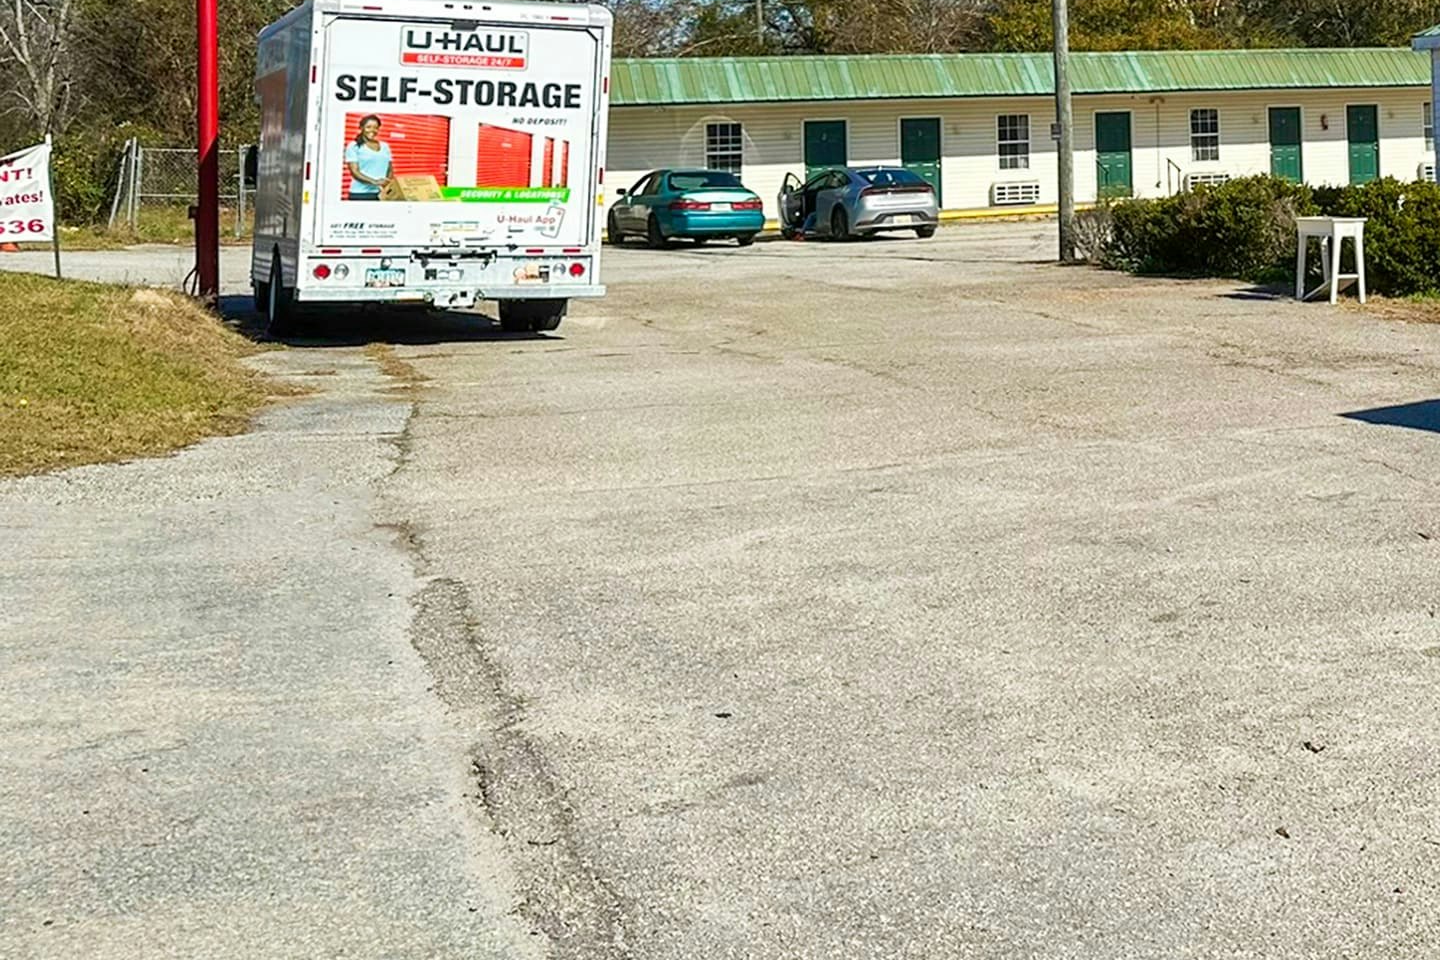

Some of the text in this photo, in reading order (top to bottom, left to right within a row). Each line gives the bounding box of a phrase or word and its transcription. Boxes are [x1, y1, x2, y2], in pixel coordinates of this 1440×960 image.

[407, 30, 523, 53] U-HAUL
[416, 54, 488, 65] SELF-STORAGE
[335, 74, 582, 109] SELF-STORAGE
[0, 190, 43, 206] ates!
[497, 215, 533, 223] U-Haul
[343, 222, 366, 230] FREE
